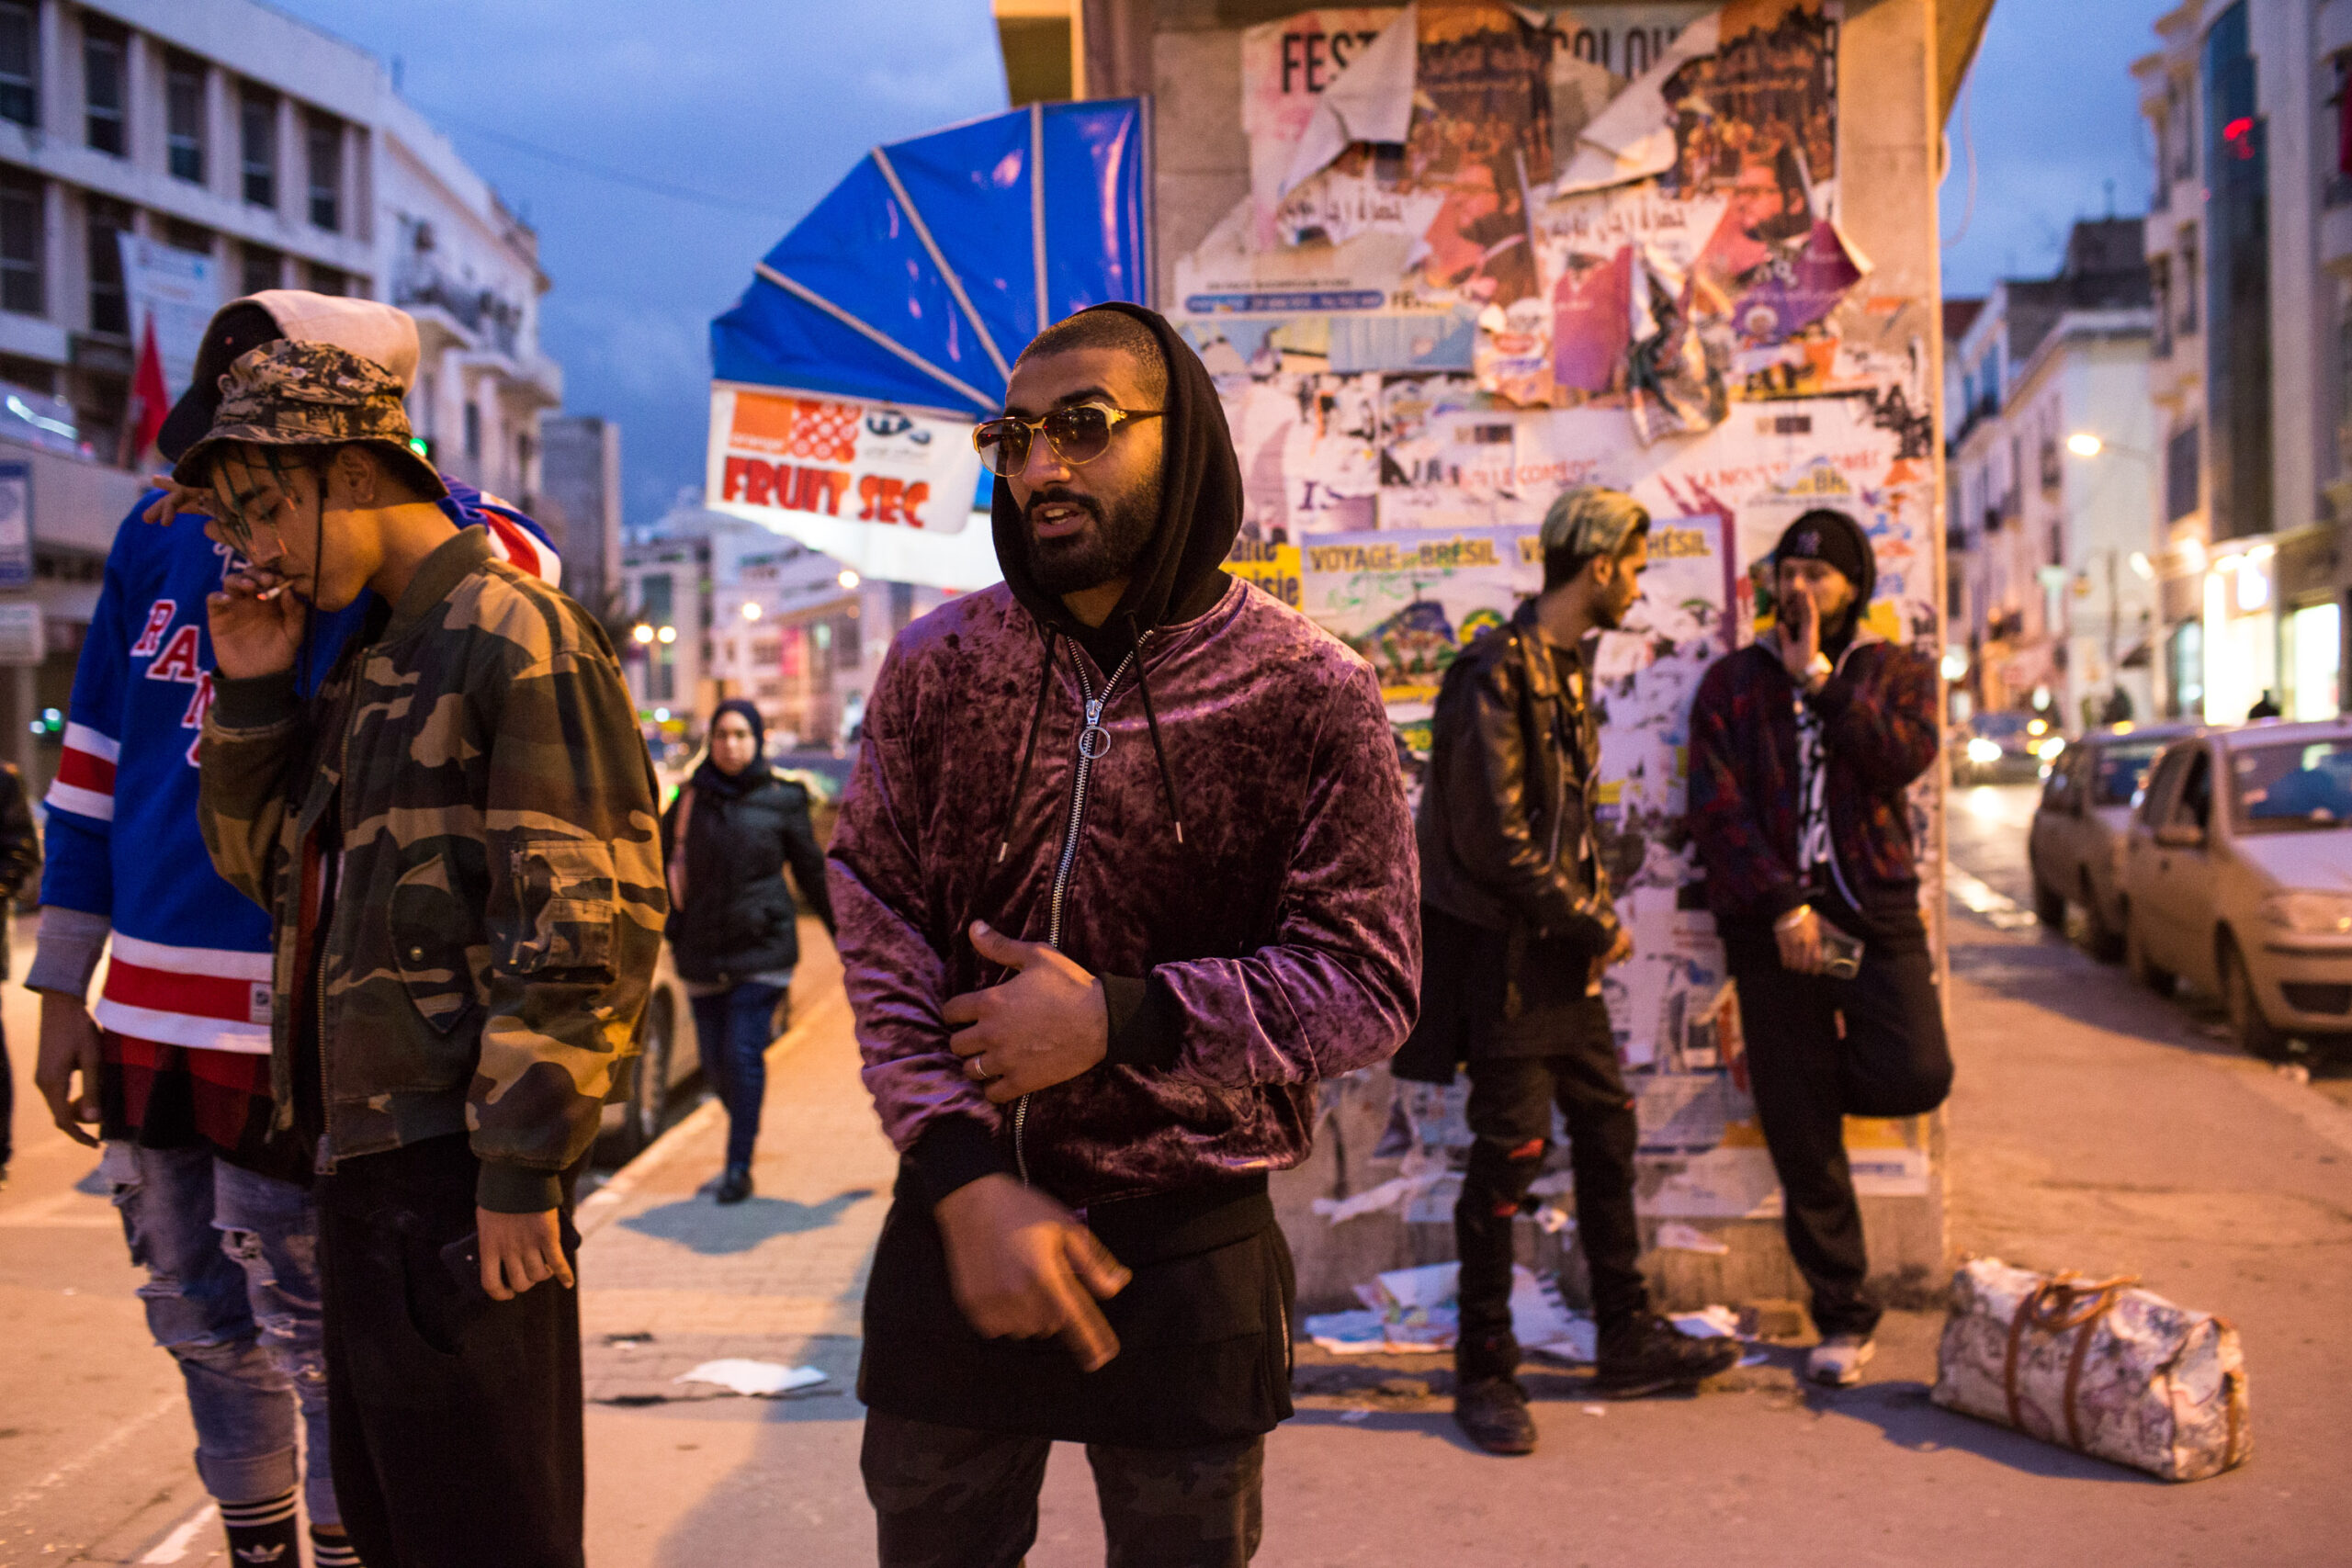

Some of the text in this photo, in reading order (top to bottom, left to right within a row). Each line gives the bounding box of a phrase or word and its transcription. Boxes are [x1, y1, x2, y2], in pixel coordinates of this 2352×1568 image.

[723, 456, 930, 528] FRUIT SEC
[1308, 544, 1400, 572] VOYAGE
[1419, 535, 1499, 568] BRÉSIL
[130, 599, 217, 766] RAN
